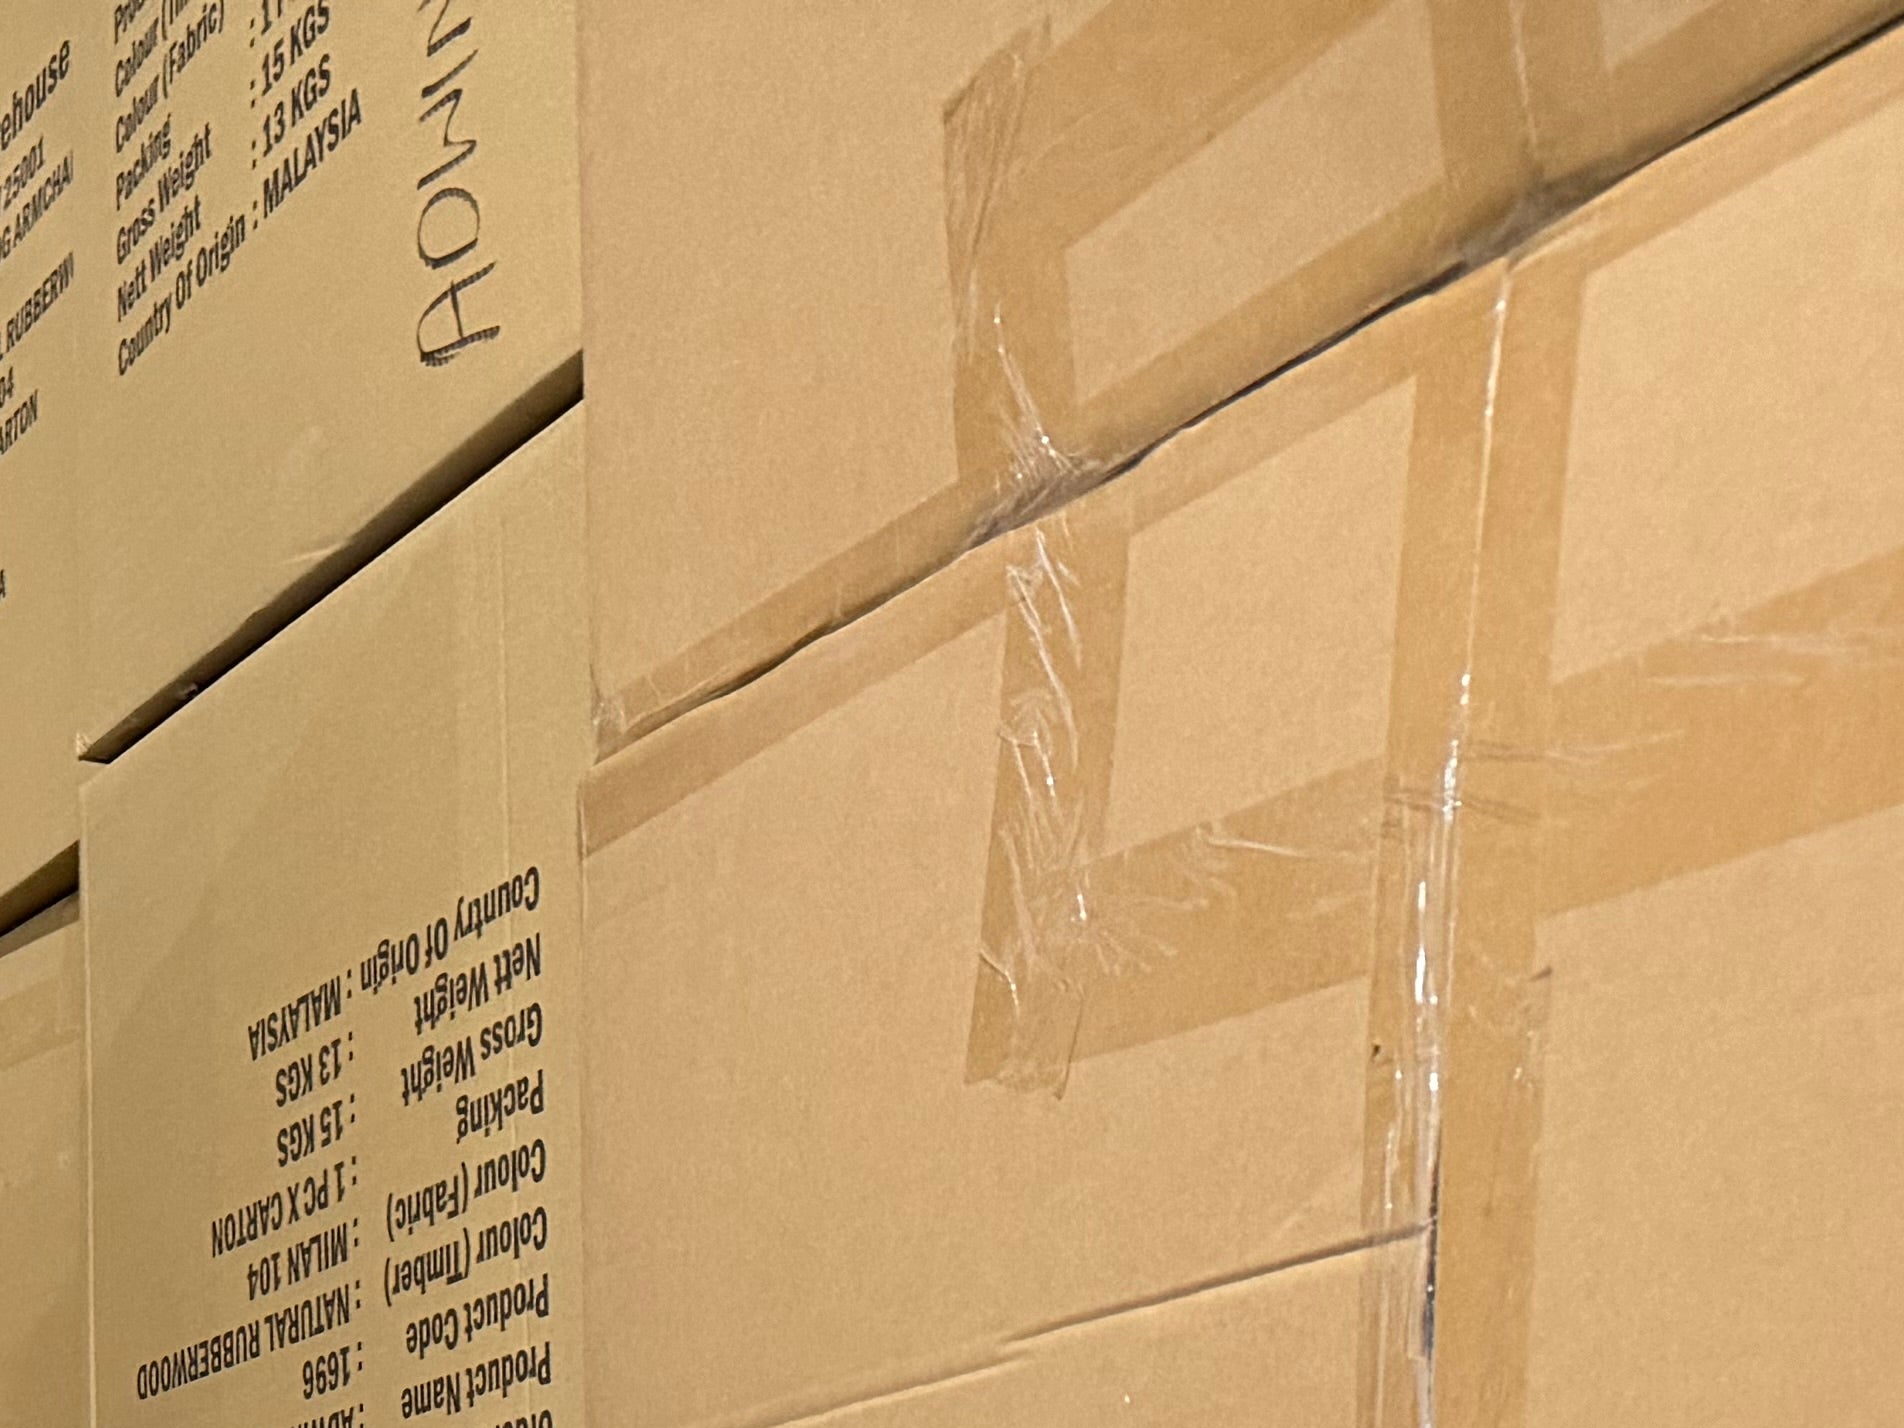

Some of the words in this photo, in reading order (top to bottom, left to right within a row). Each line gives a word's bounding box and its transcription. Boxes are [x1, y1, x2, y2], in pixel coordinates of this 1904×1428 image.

[118, 293, 172, 376] Country
[176, 259, 192, 310] Of
[196, 214, 245, 287] Origin
[263, 88, 362, 219] MALAYSIA
[387, 1161, 468, 1242] (Fabric)
[474, 1139, 546, 1198] Colour
[288, 1222, 348, 1285] MILAN
[384, 1227, 470, 1308] (Timber)
[476, 1206, 547, 1264] Colour
[247, 1252, 281, 1301] 104
[264, 1284, 349, 1352] NATURAL
[137, 1320, 260, 1400] RUBBERWOOD
